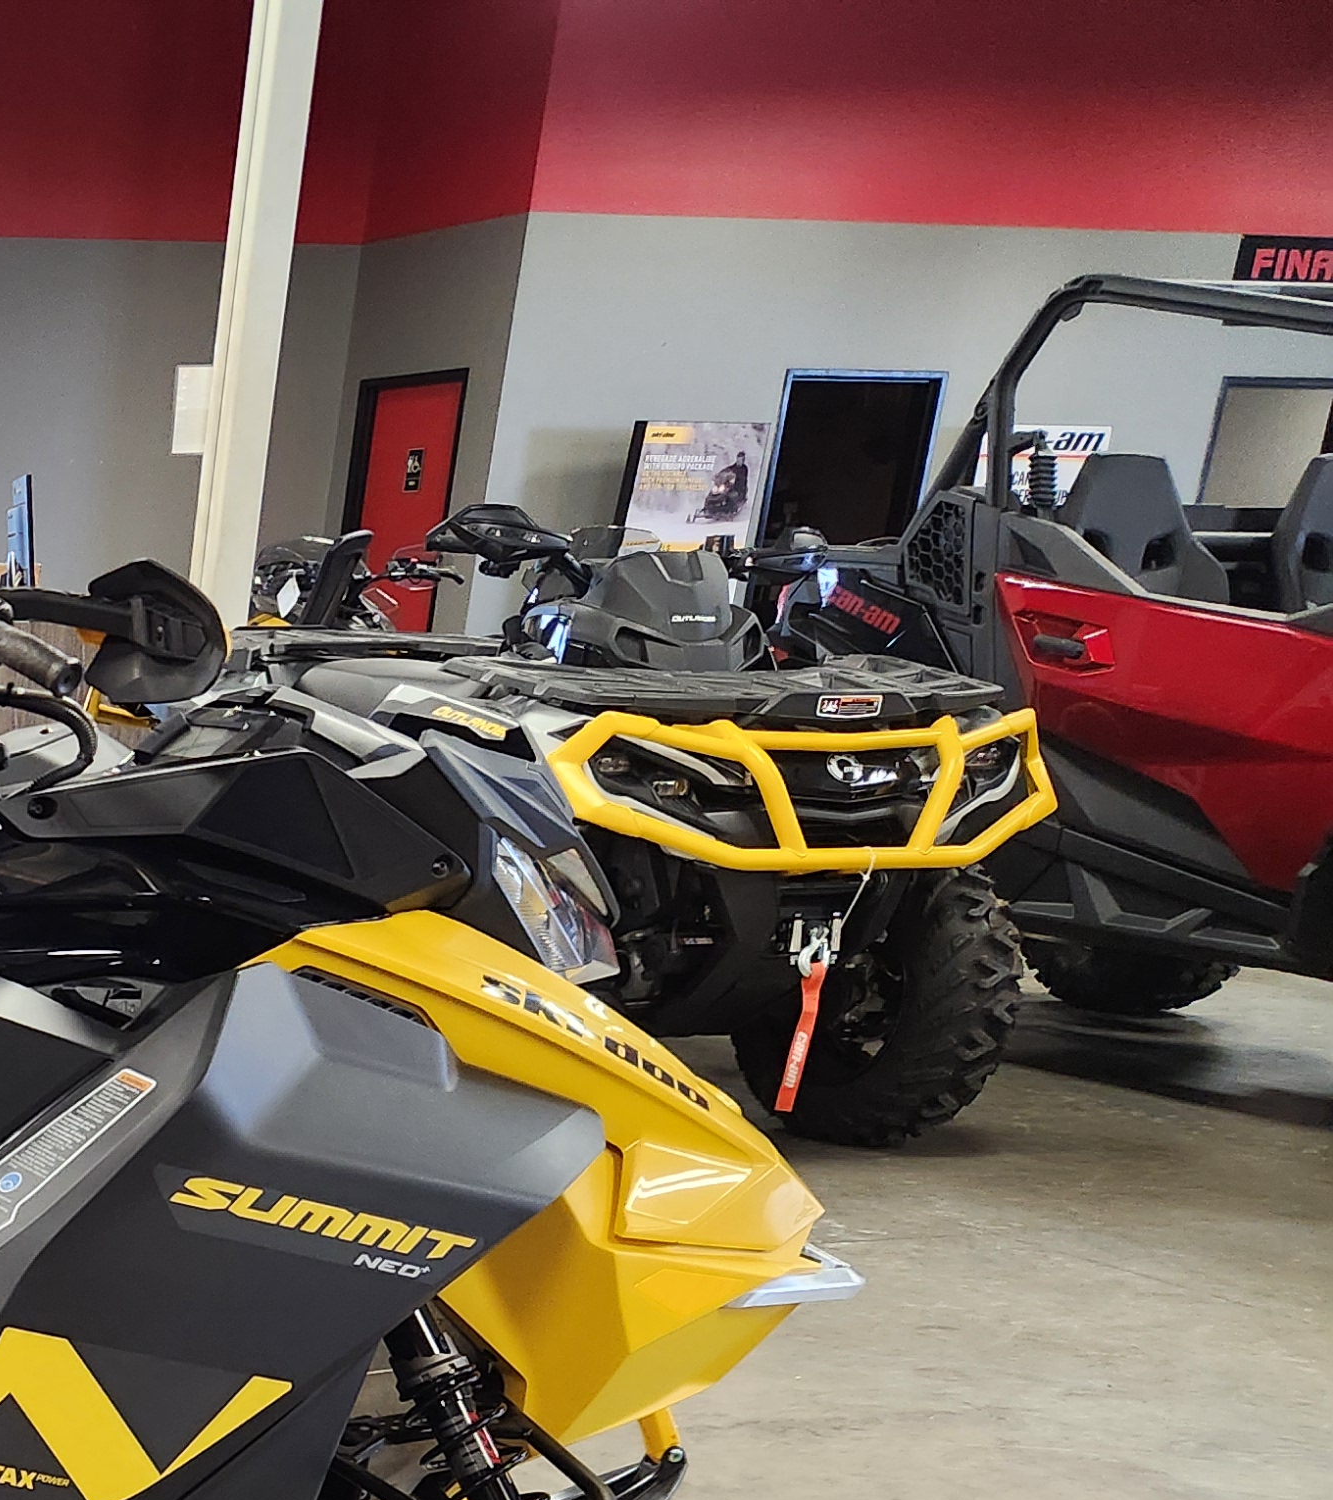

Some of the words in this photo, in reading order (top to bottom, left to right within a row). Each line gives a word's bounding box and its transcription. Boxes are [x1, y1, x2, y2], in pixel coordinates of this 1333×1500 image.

[827, 585, 901, 635] can-am
[480, 974, 711, 1112] ski-doo
[784, 1030, 809, 1089] can-am
[169, 1176, 477, 1259] SUMMIT
[36, 1473, 71, 1487] POWER
